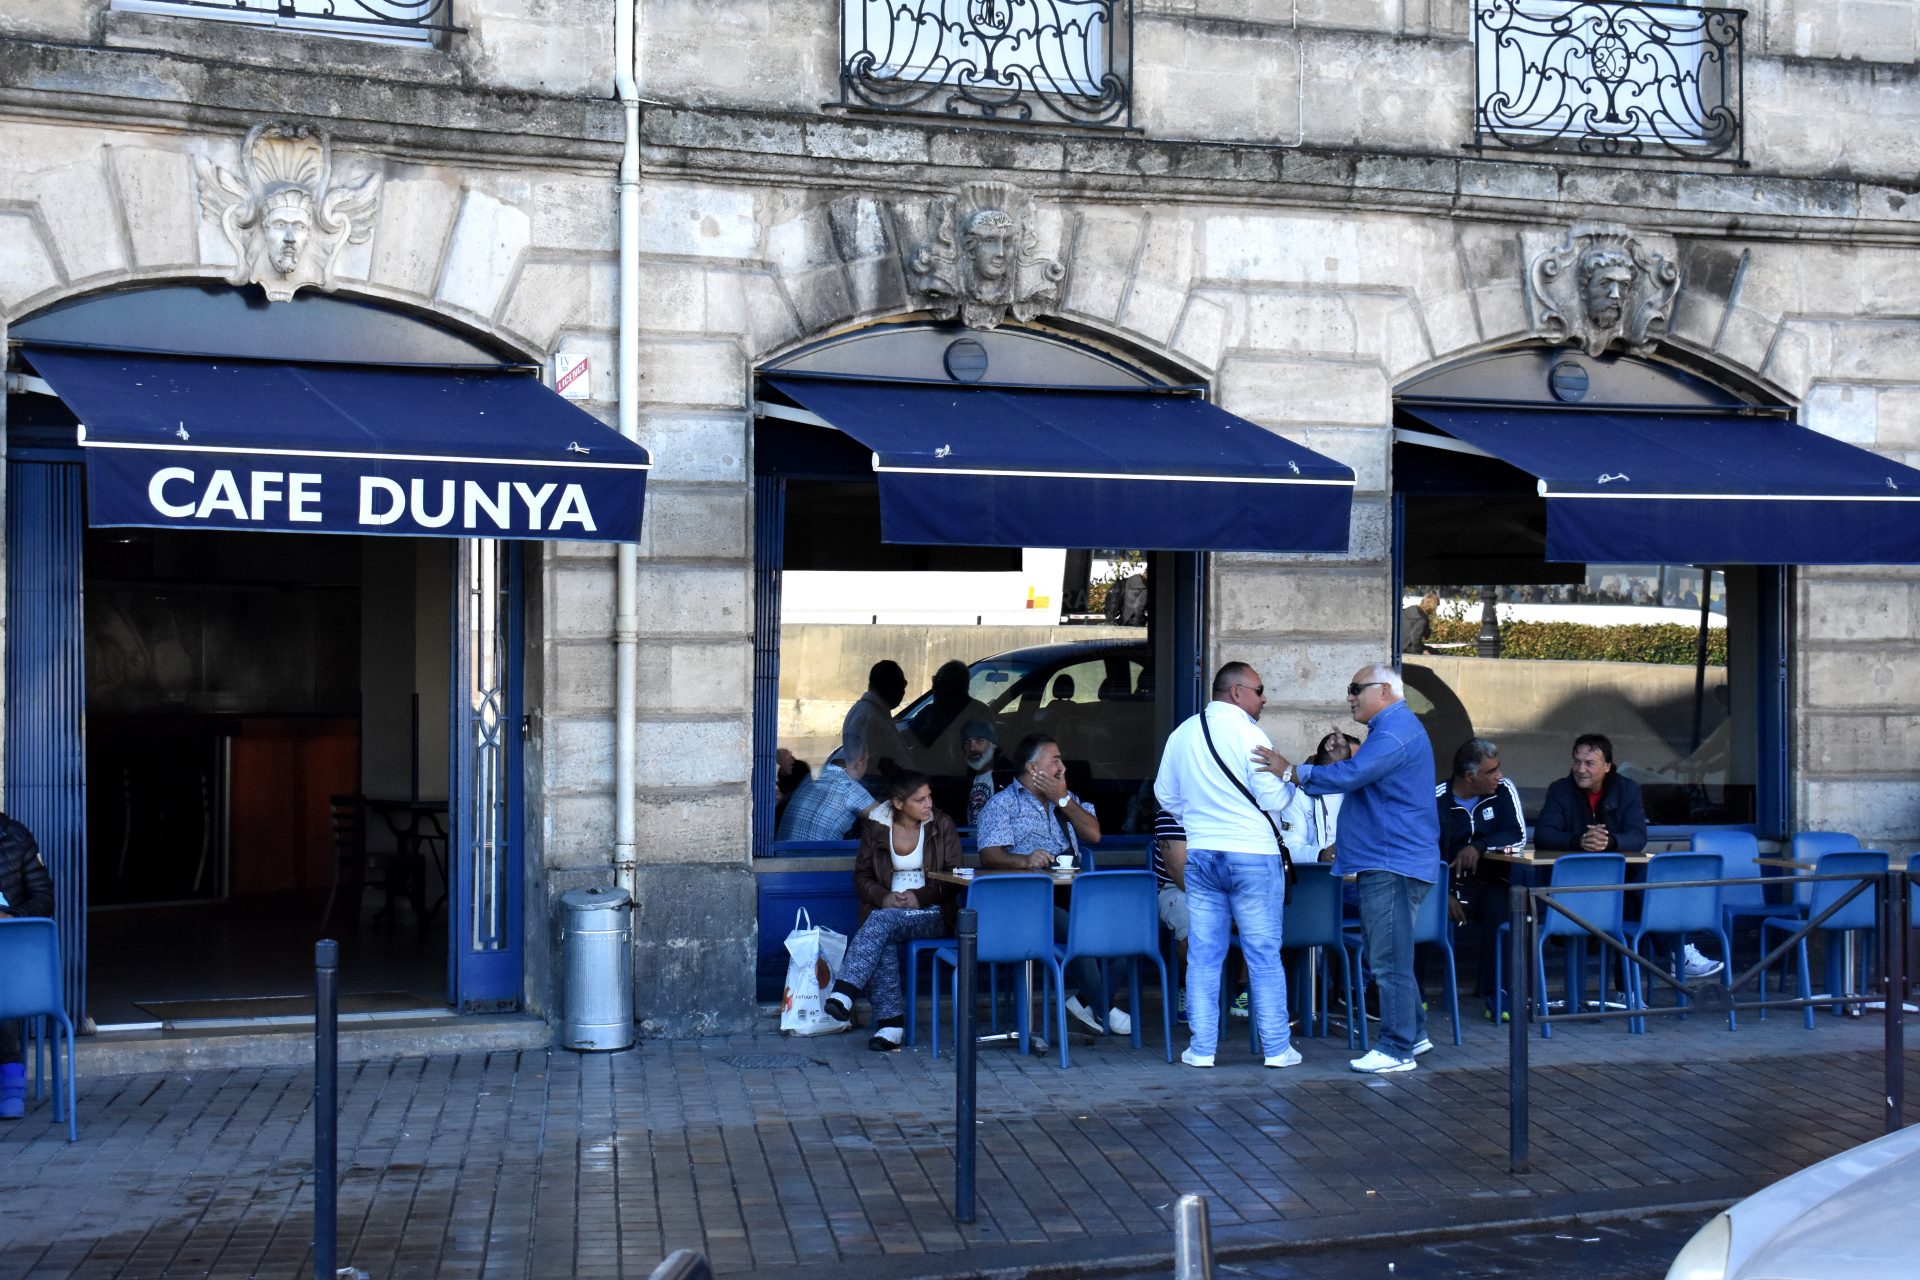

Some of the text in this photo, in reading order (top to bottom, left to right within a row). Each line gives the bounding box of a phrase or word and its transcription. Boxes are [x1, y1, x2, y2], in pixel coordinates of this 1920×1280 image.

[557, 361, 587, 391] LICENCE
[148, 467, 597, 531] CAFE DUNYA
